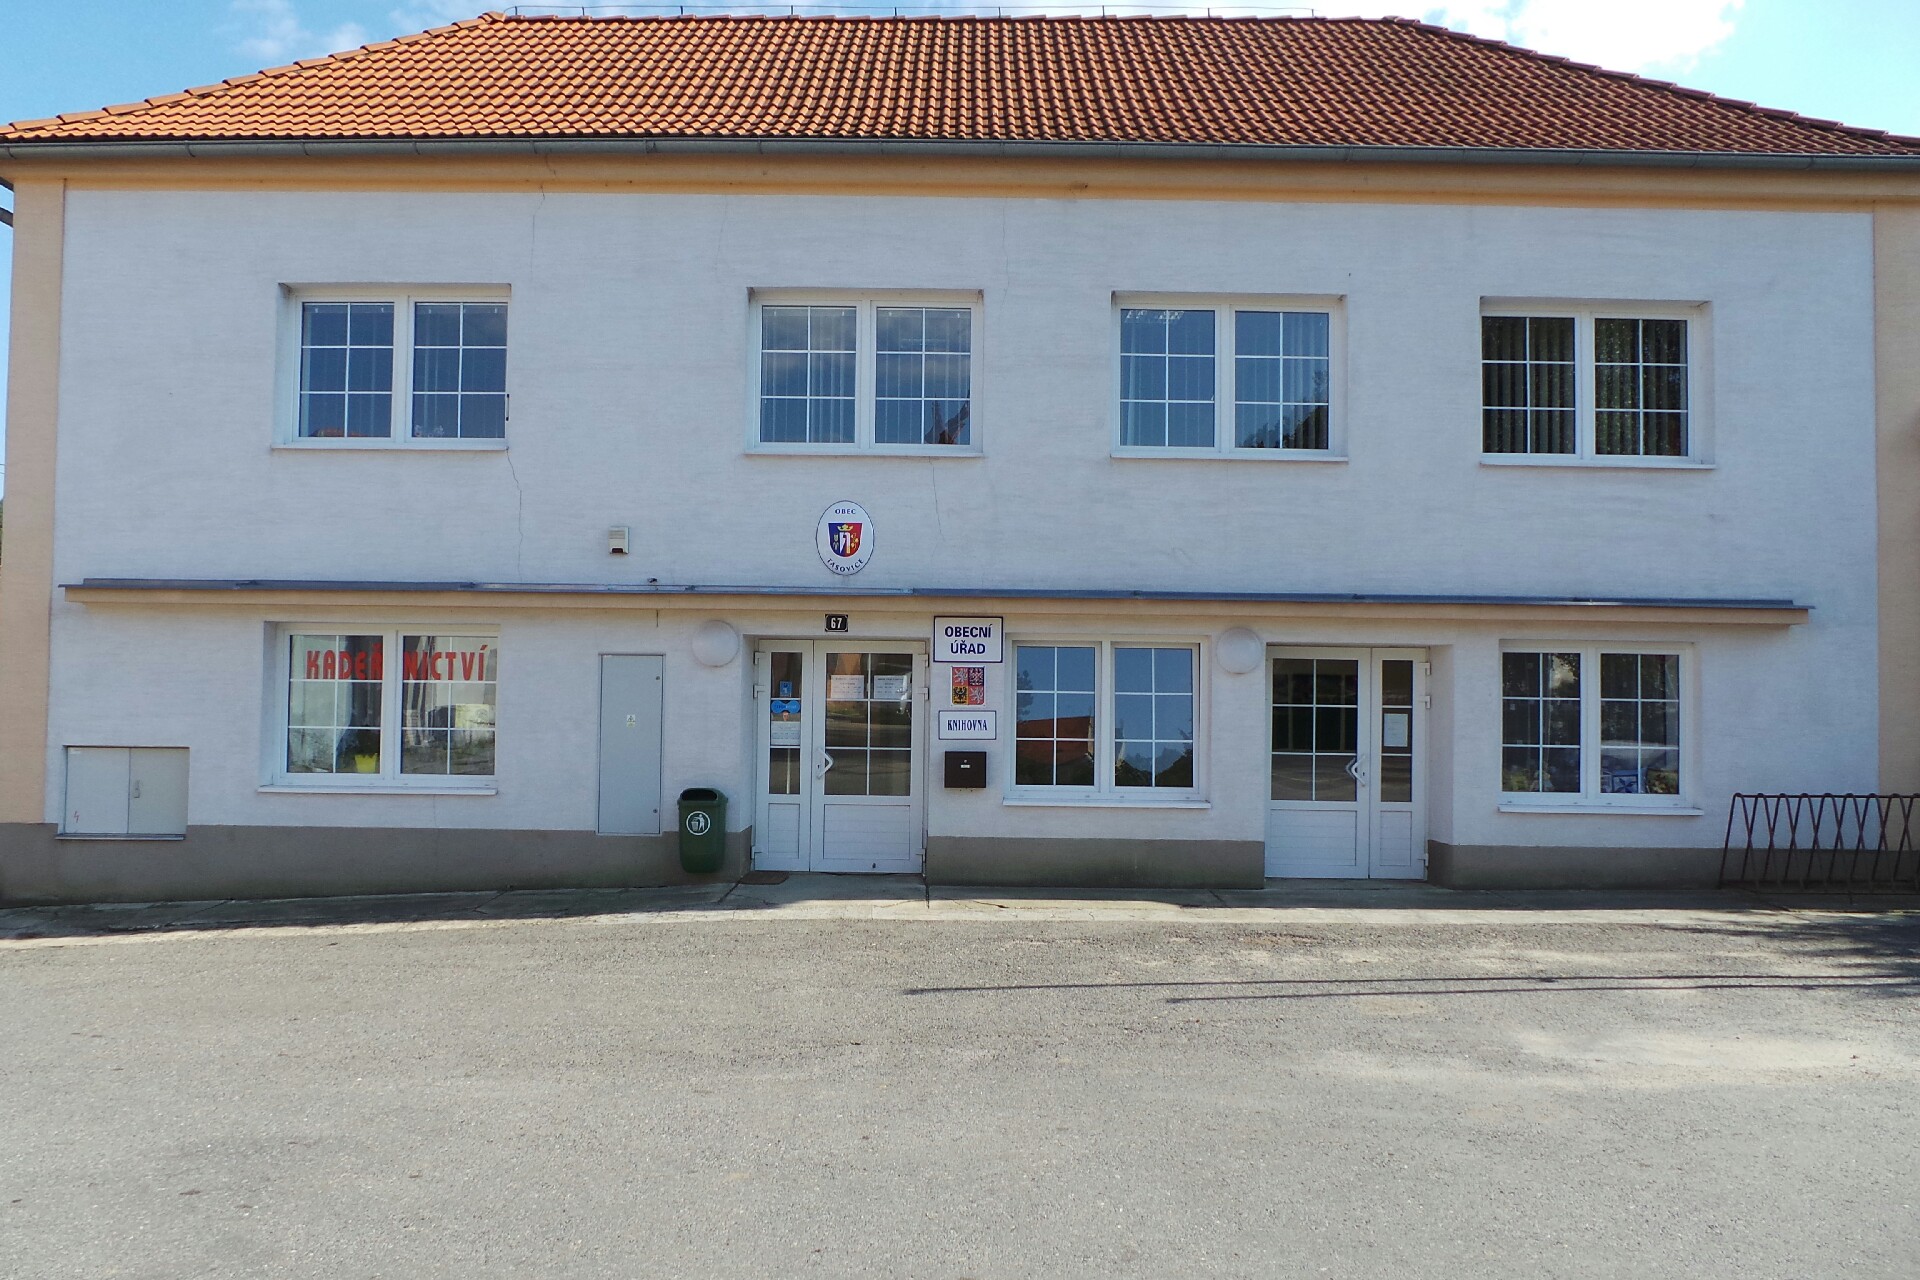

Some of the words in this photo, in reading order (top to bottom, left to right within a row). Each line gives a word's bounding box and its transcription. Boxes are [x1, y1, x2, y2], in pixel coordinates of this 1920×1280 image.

[826, 558, 864, 573] TASOVICE
[830, 617, 843, 630] 67
[944, 623, 993, 639] OBECNÍ
[950, 639, 986, 655] ÚŘAD
[947, 719, 988, 731] KNIHOVNA
